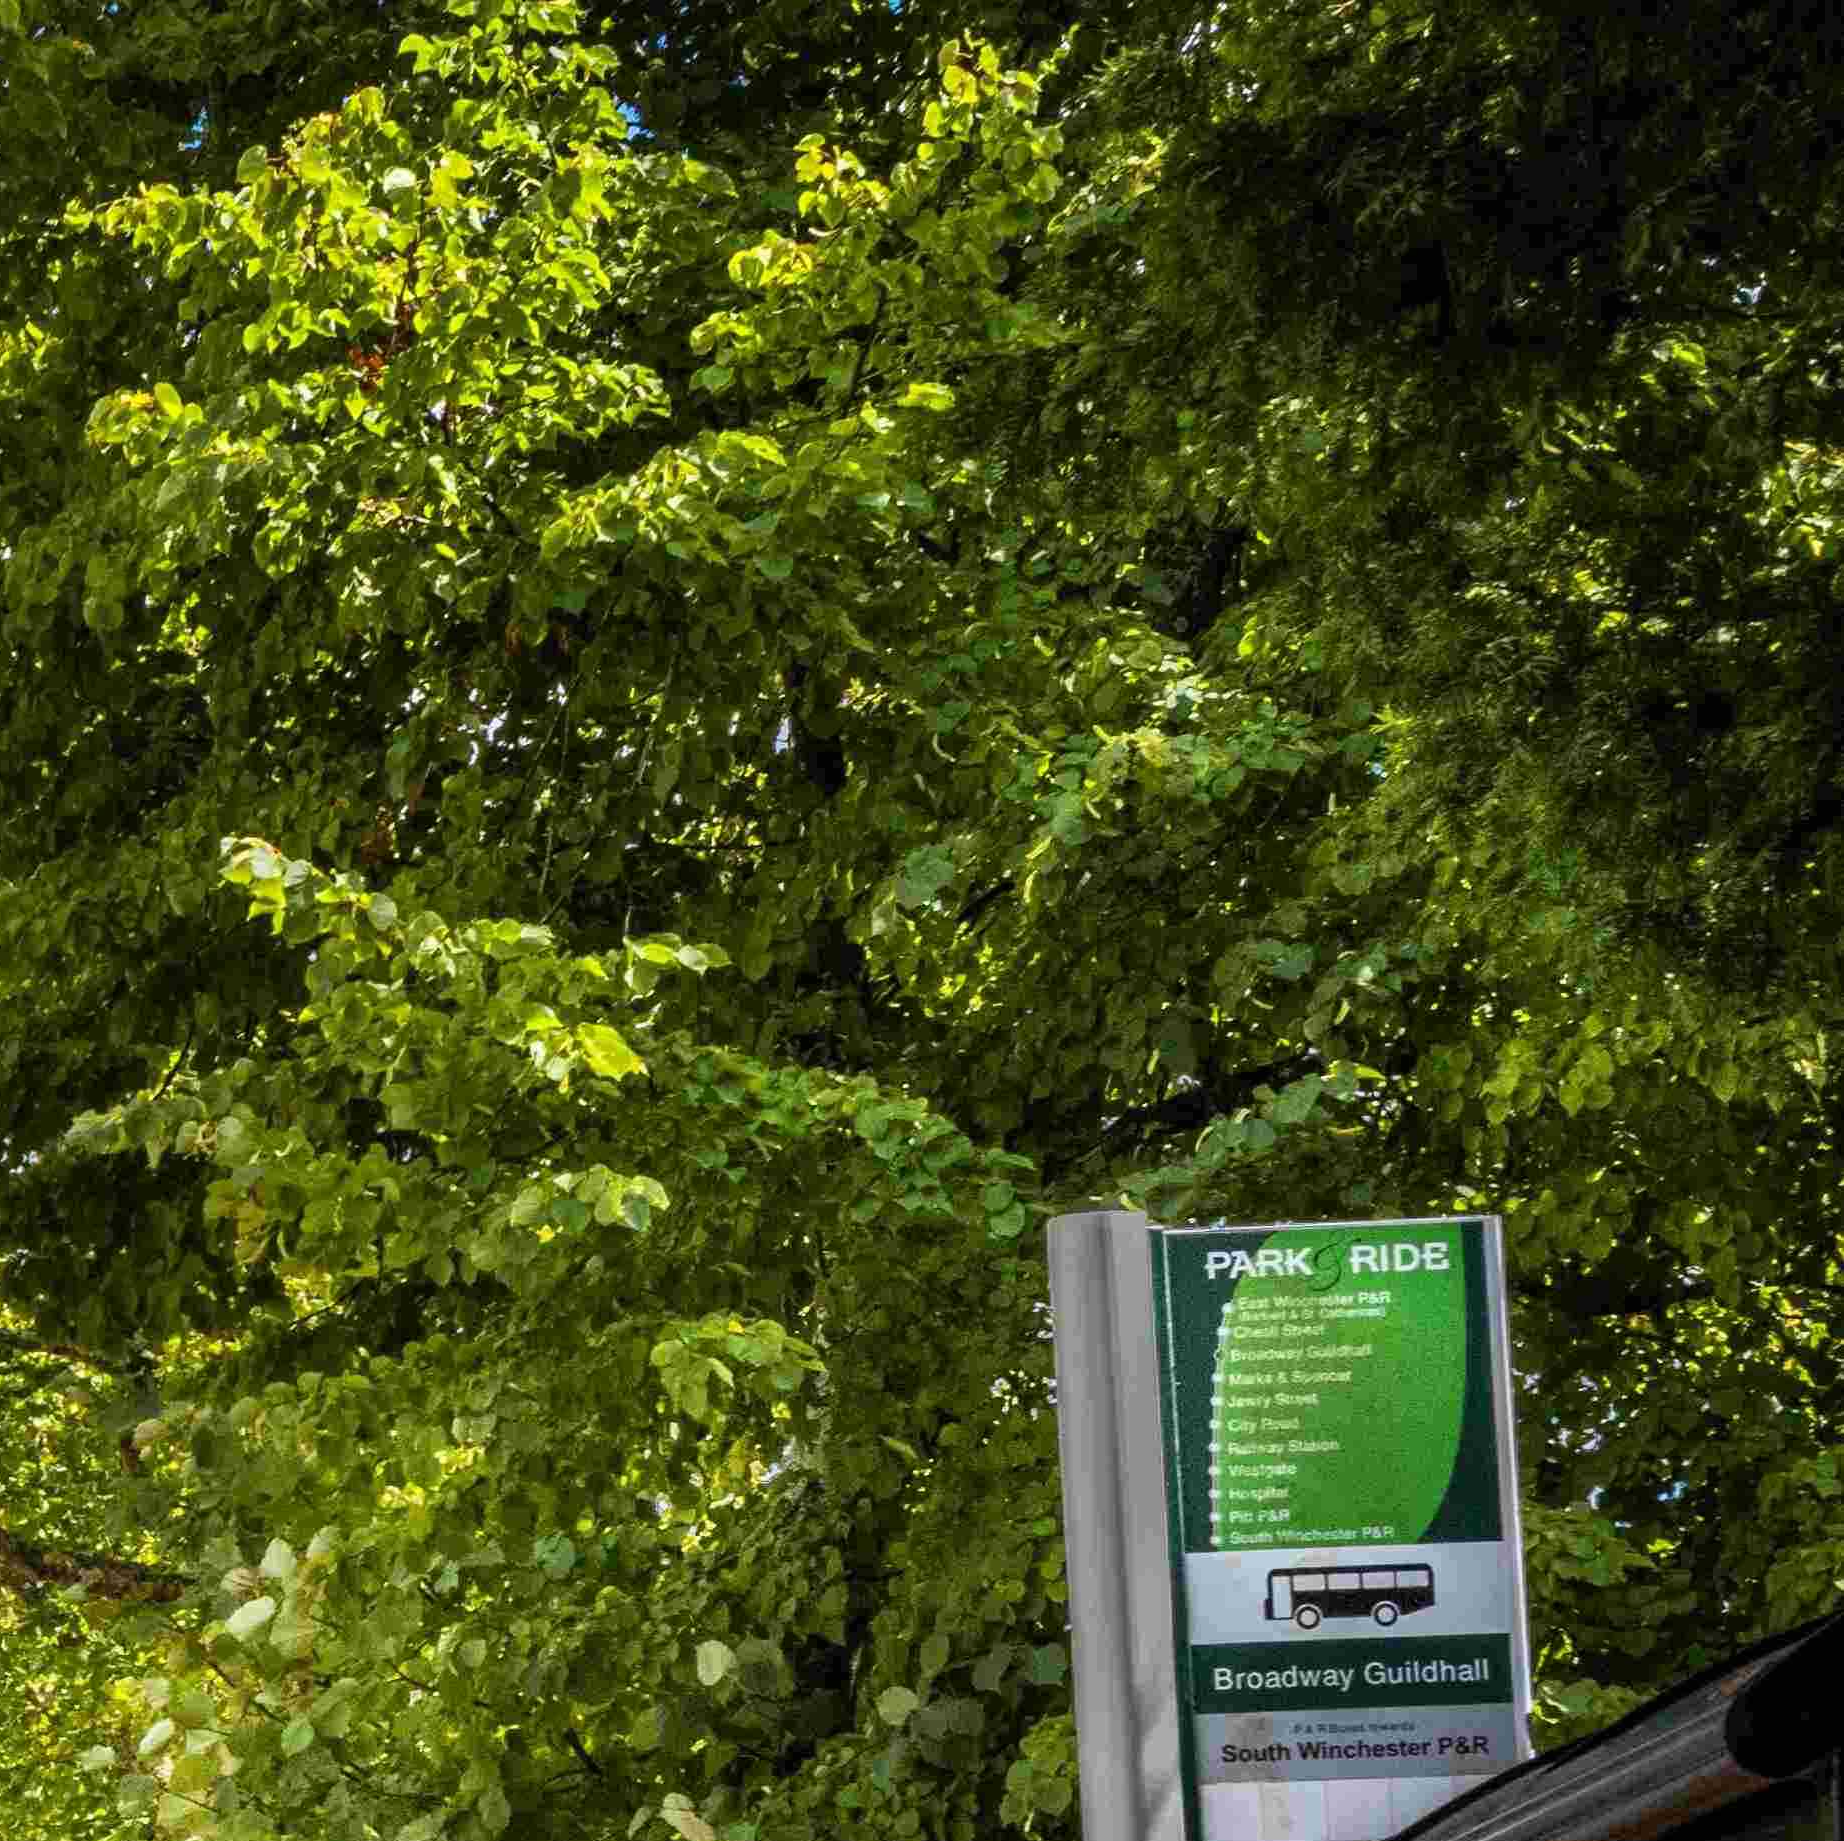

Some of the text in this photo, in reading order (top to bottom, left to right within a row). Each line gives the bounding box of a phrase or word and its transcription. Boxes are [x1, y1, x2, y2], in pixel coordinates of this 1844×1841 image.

[1204, 1247, 1314, 1279] PARK
[1349, 1241, 1451, 1274] RIDE
[1357, 1290, 1392, 1305] P&R
[1230, 1343, 1373, 1363] Broadway Guildhall
[1288, 1439, 1340, 1452] Station
[1228, 1486, 1289, 1503] Hospital
[1229, 1525, 1395, 1545] South Winchester P&R
[1214, 1658, 1490, 1692] Broadway Guildhall
[1221, 1734, 1490, 1764] South Winchester P&R
